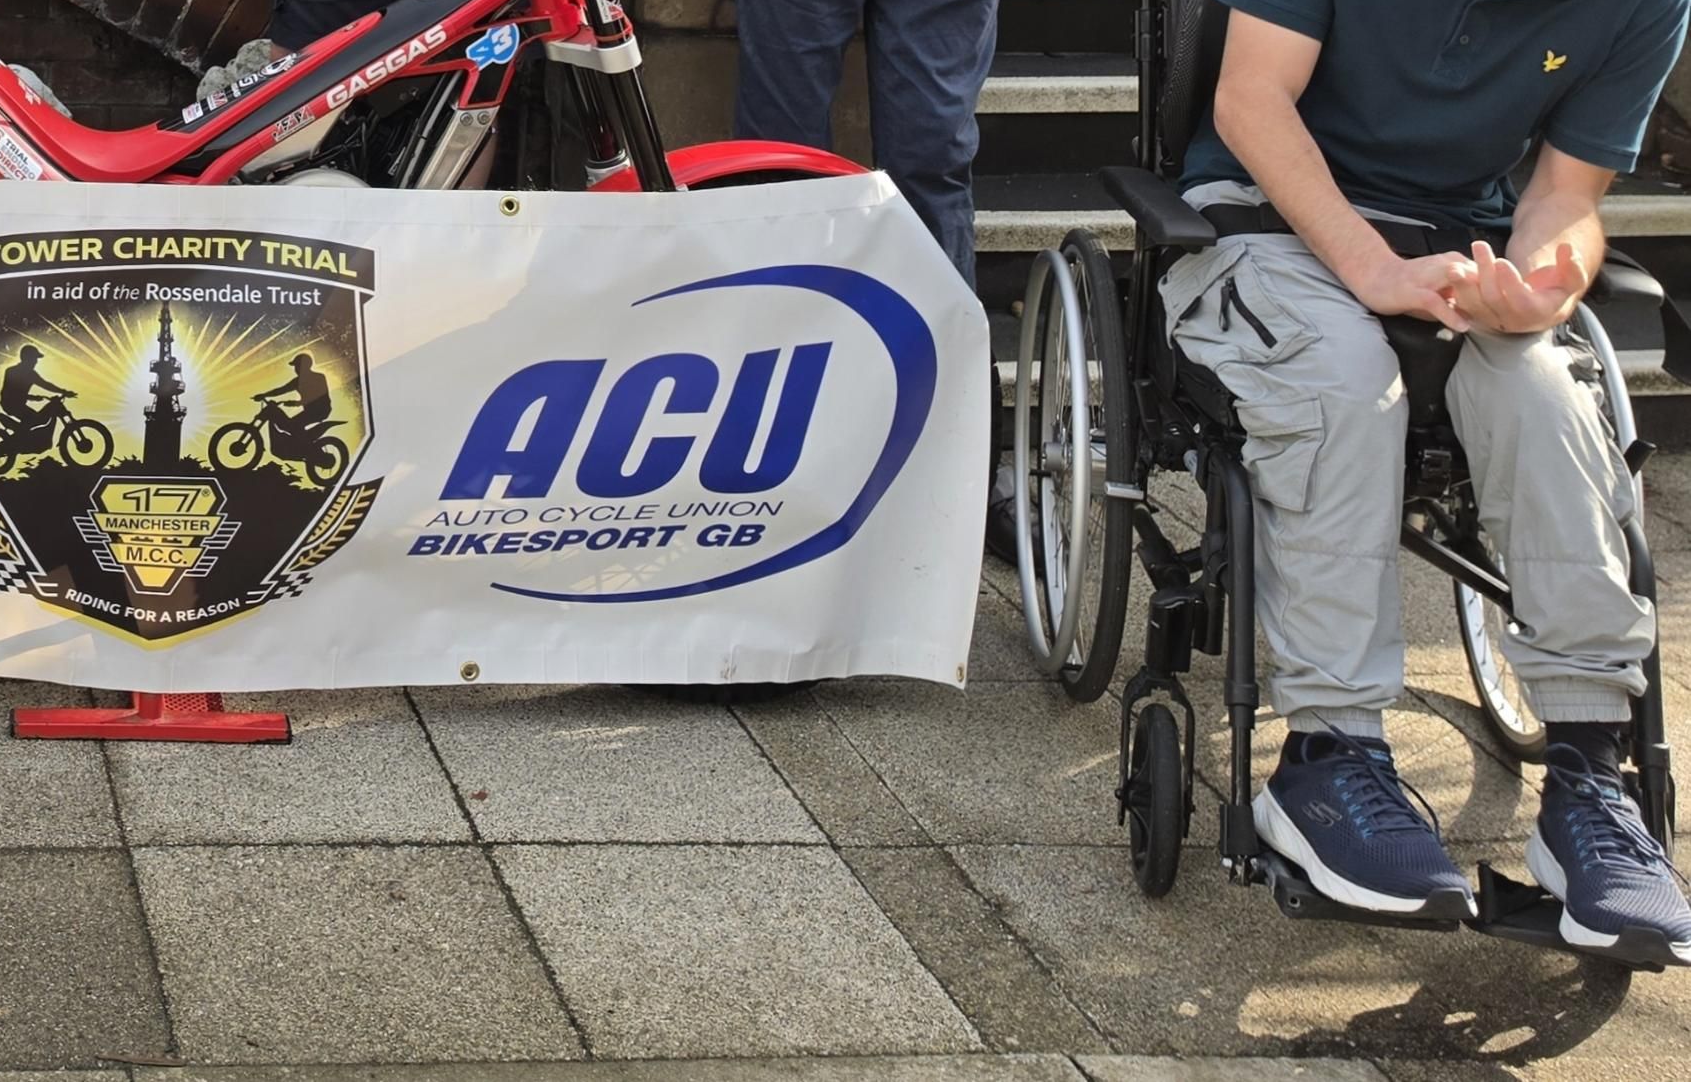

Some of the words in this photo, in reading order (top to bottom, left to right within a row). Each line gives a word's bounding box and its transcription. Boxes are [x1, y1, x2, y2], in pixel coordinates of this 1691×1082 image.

[326, 24, 448, 110] GASGAS
[6, 138, 28, 165] TRIAL
[112, 237, 253, 261] CHARITY
[260, 240, 357, 278] TRIAL
[27, 281, 46, 299] in
[52, 282, 83, 300] aid
[89, 282, 111, 300] of
[113, 284, 140, 300] the
[145, 283, 261, 304] Rossendale
[267, 286, 322, 306] Trust
[439, 341, 833, 501] ACU
[122, 487, 202, 513] 17
[425, 506, 528, 527] AUTO
[538, 503, 661, 524] CYCLE
[668, 500, 785, 518] UNION
[105, 518, 211, 531] MANCHESTER
[407, 523, 687, 557] BIKESPORT
[697, 523, 767, 548] GB
[126, 546, 188, 565] M.C.C.
[65, 588, 121, 615] RIDING
[124, 609, 156, 623] FOR
[159, 611, 172, 623] A
[176, 598, 241, 623] REASON
